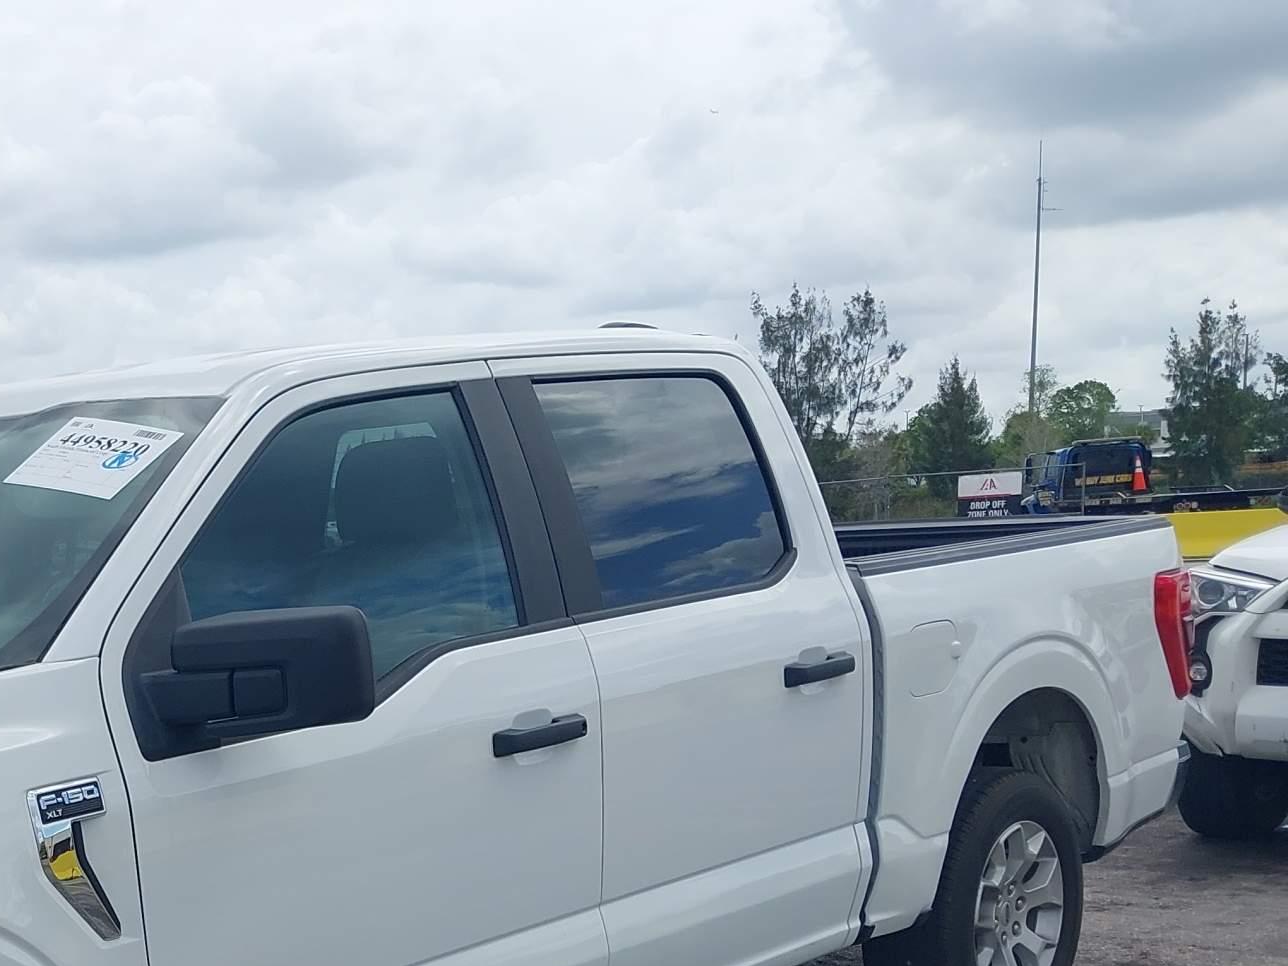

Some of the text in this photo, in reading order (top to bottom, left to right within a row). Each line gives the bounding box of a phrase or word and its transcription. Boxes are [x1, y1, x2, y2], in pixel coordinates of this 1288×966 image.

[59, 432, 150, 457] 44958220
[970, 500, 1007, 510] DROP OFF
[988, 509, 1009, 517] ONLY
[39, 785, 100, 810] F-150
[46, 809, 62, 820] XLT
